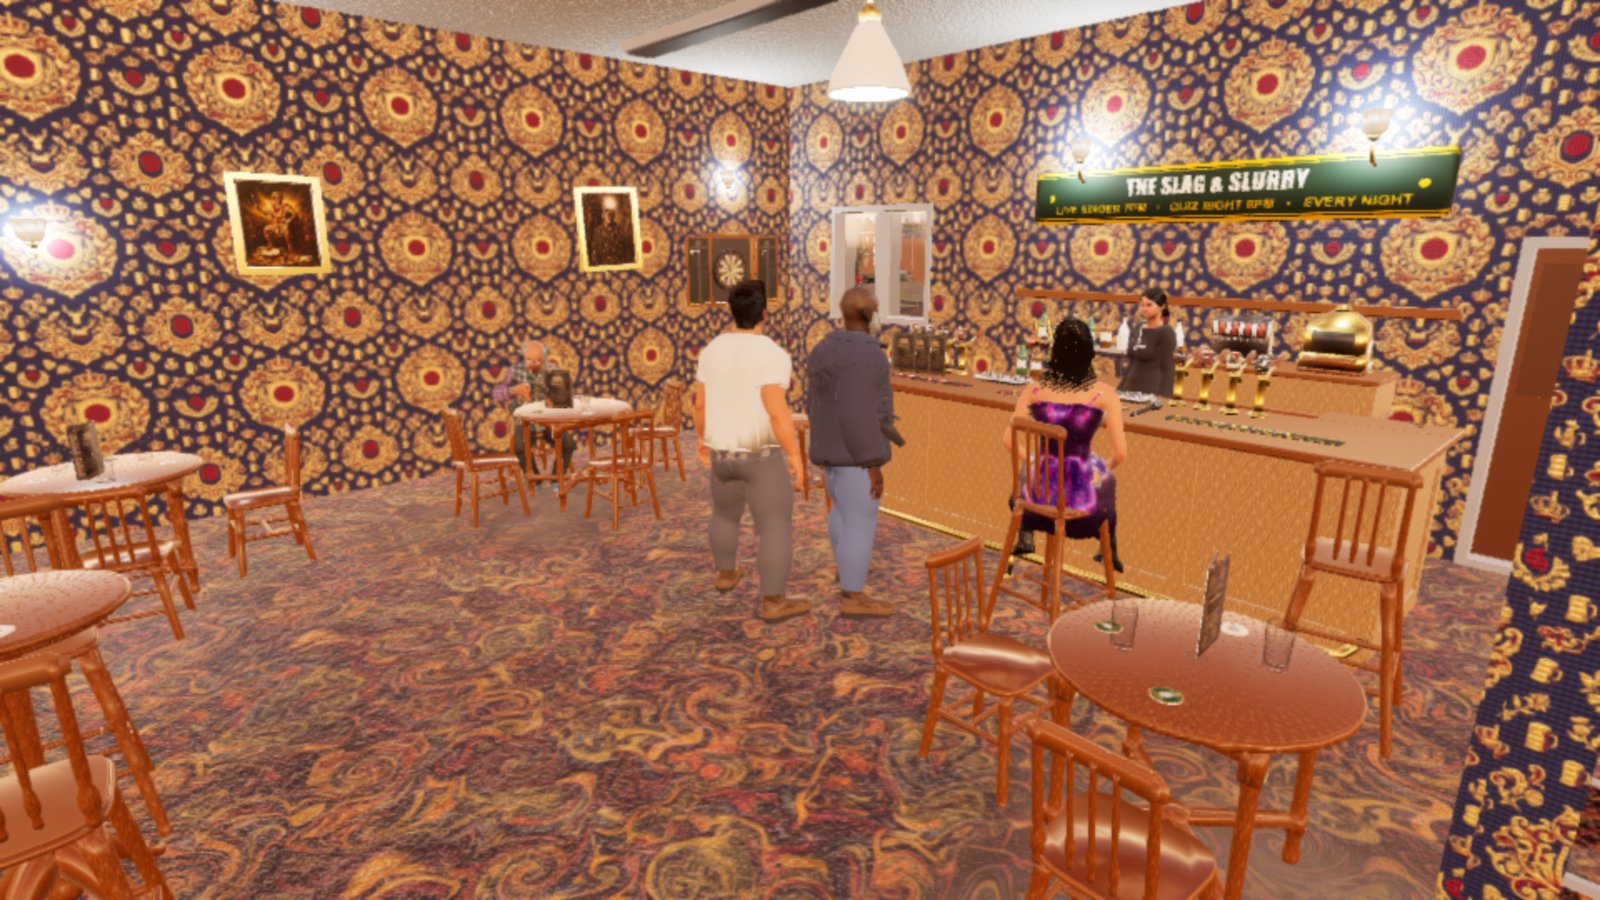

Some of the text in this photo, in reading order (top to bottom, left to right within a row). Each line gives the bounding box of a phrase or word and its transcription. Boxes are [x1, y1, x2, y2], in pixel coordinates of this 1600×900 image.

[1126, 168, 1311, 197] THE SLAG & SLURRY
[1169, 200, 1199, 212] QUIZ
[1203, 199, 1242, 211] NIGHT
[1303, 194, 1357, 208] EVERY
[1361, 192, 1414, 206] NIGHT
